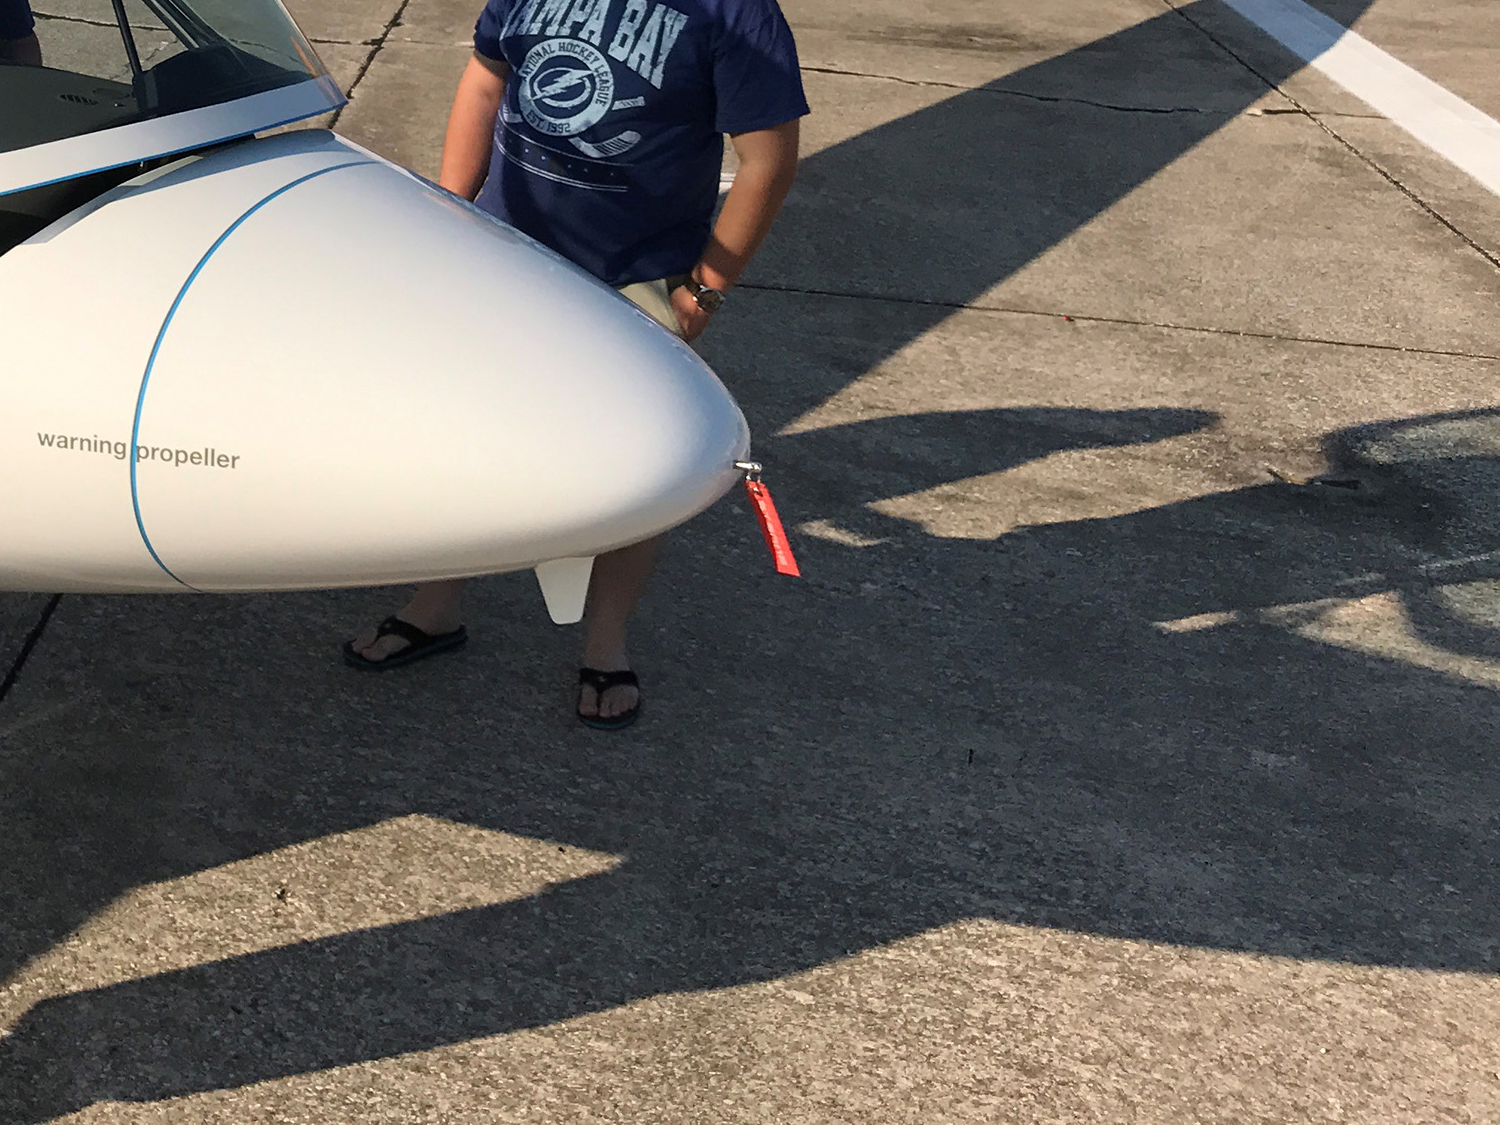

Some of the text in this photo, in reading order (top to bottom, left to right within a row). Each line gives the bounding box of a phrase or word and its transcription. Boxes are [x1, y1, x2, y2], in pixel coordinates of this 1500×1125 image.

[558, 41, 600, 65] HOCKEY
[594, 64, 610, 107] LEAGUE
[546, 122, 571, 134] 1992
[37, 431, 241, 469] warning propeller
